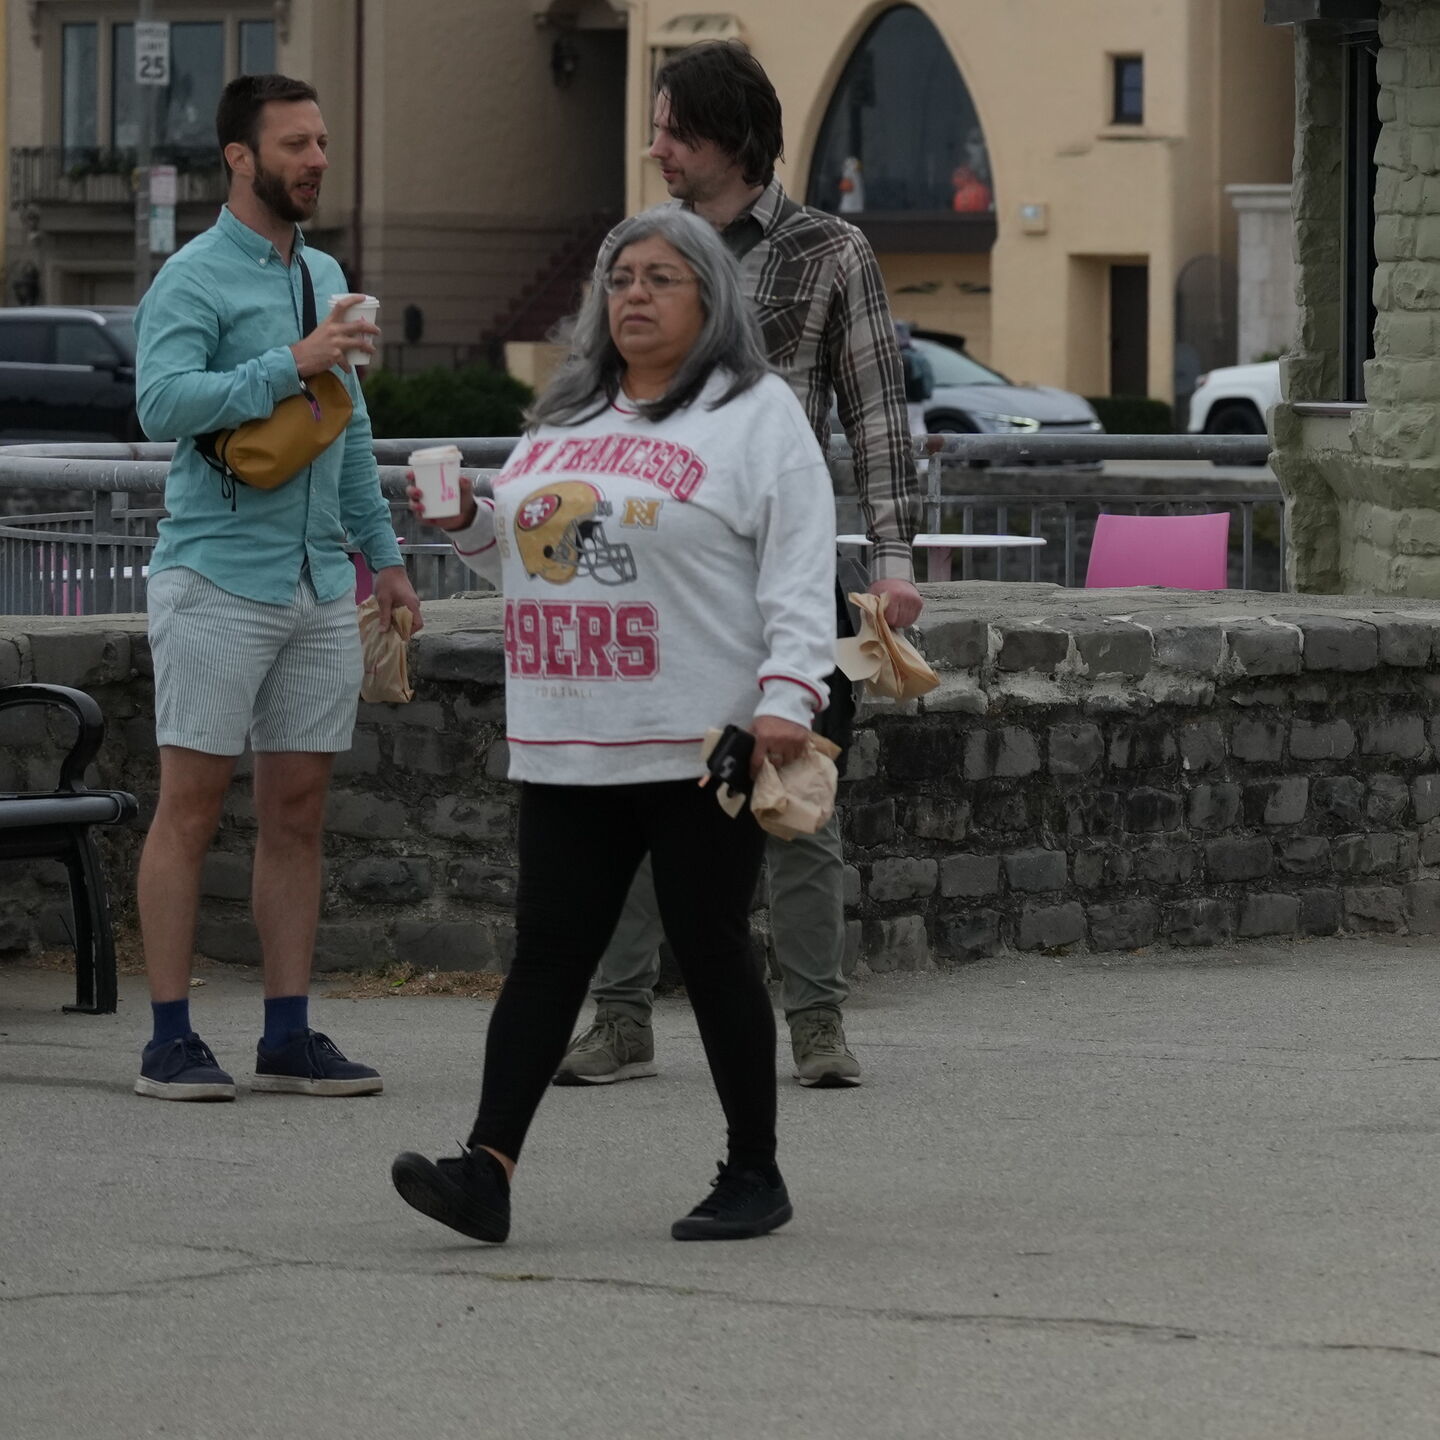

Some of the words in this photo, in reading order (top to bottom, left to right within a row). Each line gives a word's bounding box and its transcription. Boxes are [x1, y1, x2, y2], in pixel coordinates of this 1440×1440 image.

[140, 55, 164, 78] 25
[542, 433, 708, 503] FRANCISCO
[504, 598, 660, 682] 49ERS
